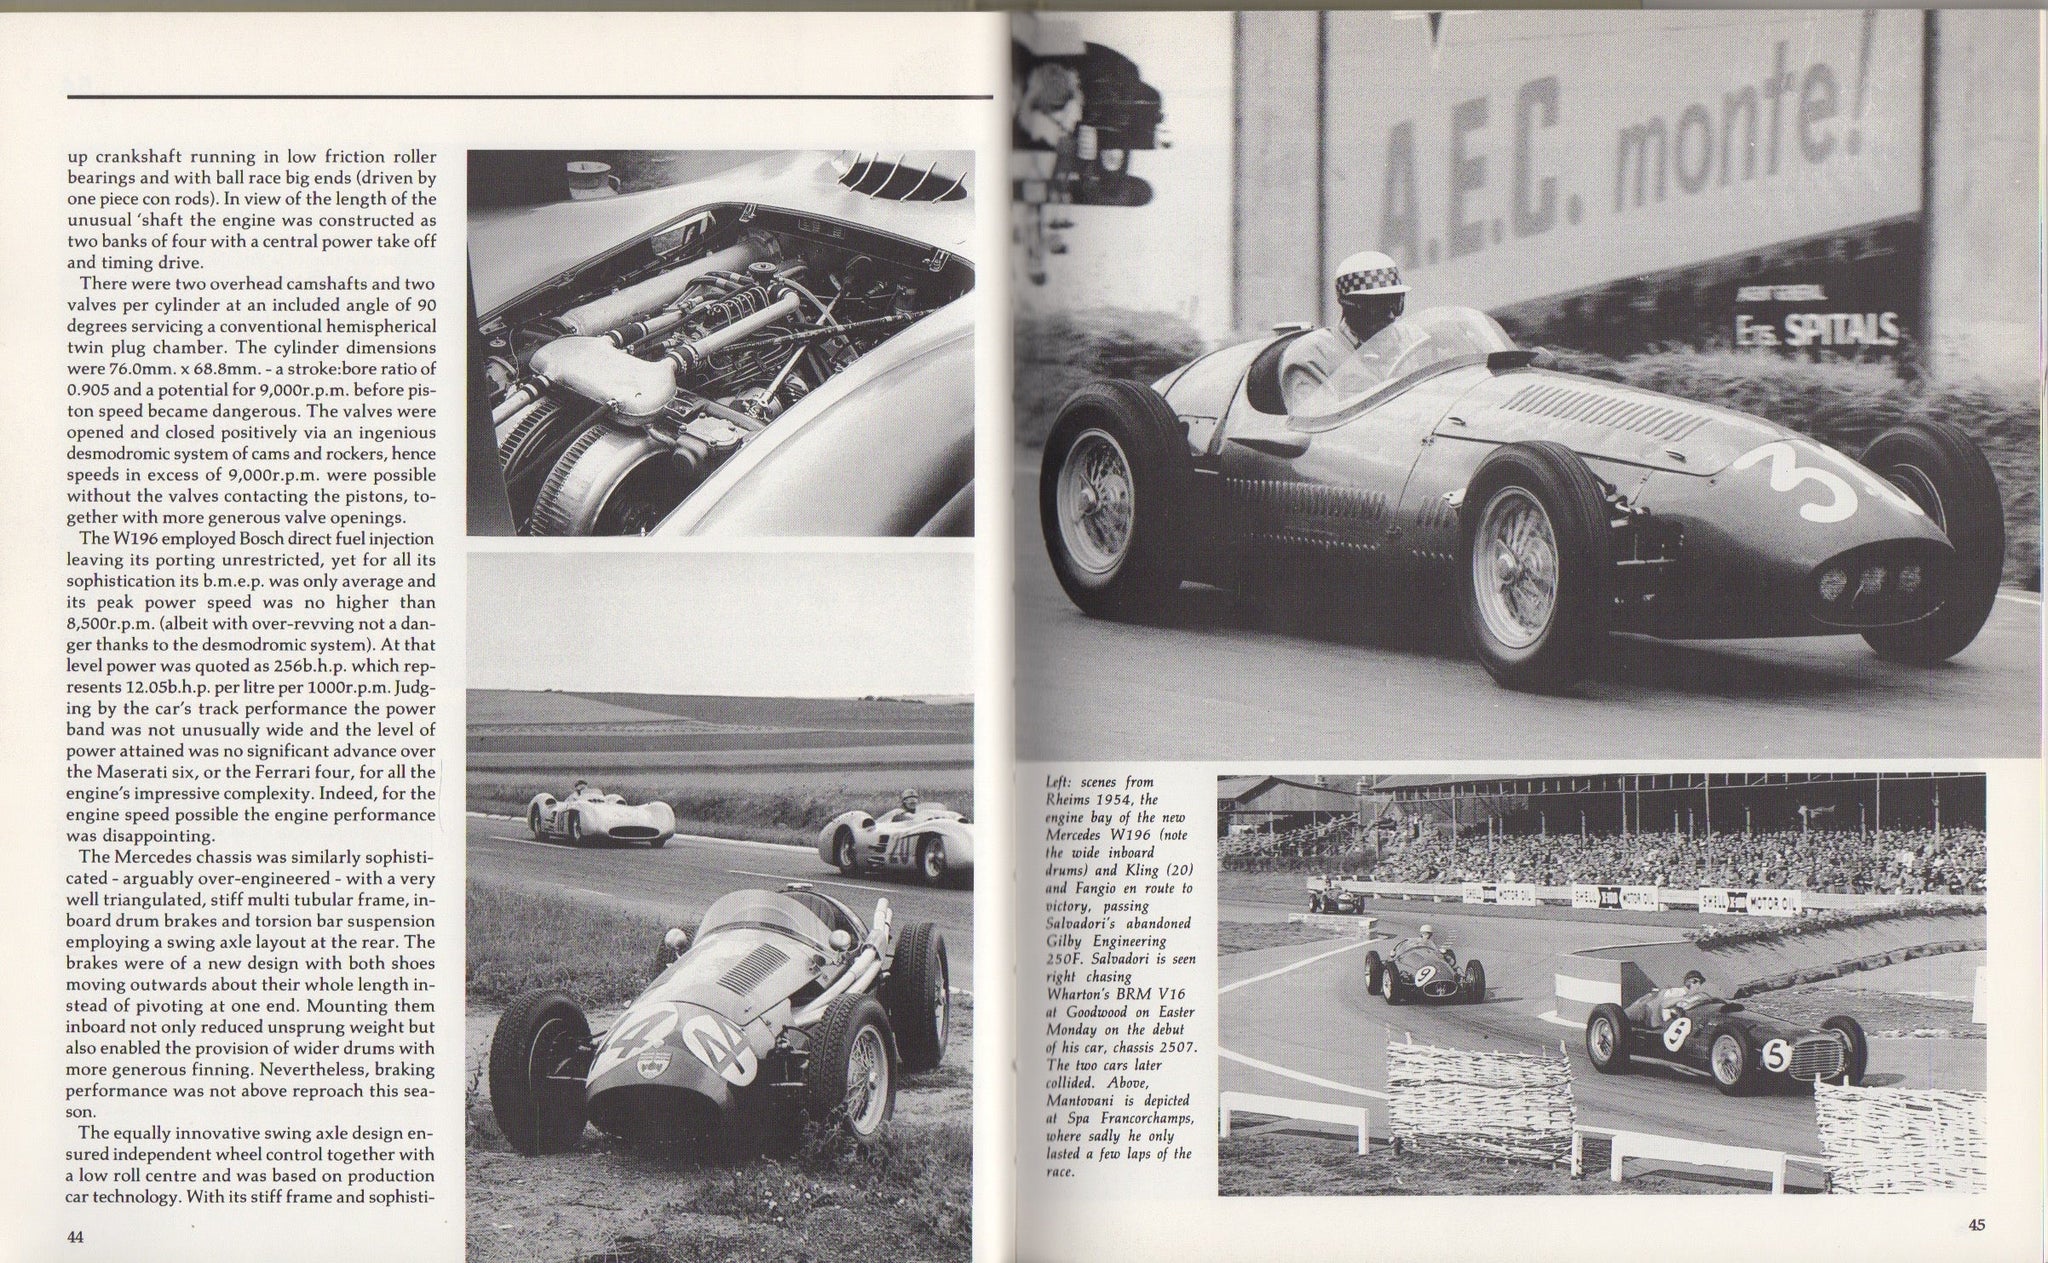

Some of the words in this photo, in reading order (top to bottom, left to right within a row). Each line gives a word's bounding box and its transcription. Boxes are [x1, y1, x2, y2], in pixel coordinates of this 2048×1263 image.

[67, 153, 88, 167] up
[95, 147, 183, 164] crankshaft
[190, 149, 256, 167] running
[264, 150, 279, 164] in
[287, 148, 317, 164] low
[325, 147, 385, 164] friction
[393, 148, 438, 164] roller
[79, 275, 128, 291] There
[131, 280, 171, 291] were
[175, 278, 207, 291] two
[209, 275, 283, 291] overhead
[286, 275, 368, 291] camshafts
[371, 275, 401, 291] and
[404, 278, 436, 291] two
[67, 405, 94, 418] ton
[98, 402, 144, 422] speed
[147, 402, 209, 418] became
[212, 402, 301, 422] dangerous.
[305, 402, 339, 418] The
[342, 402, 393, 418] valves
[396, 407, 437, 418] were
[78, 529, 110, 545] The
[113, 530, 159, 546] W196
[161, 530, 236, 550] employed
[239, 529, 285, 546] Bosch
[287, 530, 333, 546] direct
[335, 530, 366, 546] fuel
[369, 531, 435, 550] injection
[1045, 774, 1072, 791] Left:
[1080, 778, 1117, 788] scenes
[1124, 774, 1155, 791] from
[1046, 791, 1091, 806] Rheims
[1096, 793, 1135, 807] 1954,
[1139, 791, 1159, 806] the
[65, 807, 120, 825] engine
[124, 806, 170, 826] speed
[174, 805, 239, 826] possible
[244, 805, 270, 822] the
[274, 808, 329, 825] engine
[333, 806, 437, 826] performance
[1045, 810, 1084, 827] engine
[1090, 809, 1113, 827] bay
[1118, 809, 1132, 827] of
[1137, 809, 1156, 824] the
[1162, 814, 1186, 824] new
[1045, 827, 1101, 842] Mercedes
[1110, 827, 1151, 841] W196
[1159, 827, 1188, 842] (note
[1045, 844, 1064, 859] the
[1071, 844, 1100, 859] wide
[1108, 844, 1156, 859] inboard
[1045, 862, 1089, 878] drums)
[1094, 862, 1118, 877] and
[1124, 862, 1160, 880] Kling
[1166, 862, 1194, 877] (20)
[1045, 880, 1068, 895] and
[1075, 880, 1117, 898] Fangio
[1123, 884, 1137, 895] en
[1144, 882, 1175, 895] route
[1181, 882, 1194, 894] to
[1045, 899, 1092, 916] victory,
[1103, 899, 1150, 916] passing
[1126, 915, 1192, 930] abandoned
[1046, 933, 1082, 951] Gilby
[1092, 933, 1167, 951] Engineering
[66, 954, 118, 970] brakes
[124, 959, 165, 970] were
[169, 954, 188, 970] of
[192, 960, 202, 970] a
[208, 959, 242, 970] new
[247, 954, 299, 974] design
[304, 954, 343, 971] with
[348, 954, 386, 971] both
[391, 954, 436, 971] shoes
[1046, 951, 1084, 966] 250F.
[1090, 950, 1150, 966] Salvadori
[1156, 952, 1167, 965] is
[1172, 955, 1197, 965] seen
[1046, 968, 1076, 986] right
[1086, 968, 1133, 986] chasing
[1417, 967, 1432, 983] 9
[1116, 986, 1153, 1001] BRM
[1158, 987, 1186, 1001] V16
[1045, 1006, 1057, 1019] at
[1065, 1004, 1128, 1019] Goodwood
[1135, 1008, 1150, 1019] on
[1158, 1004, 1196, 1018] Easter
[1046, 1021, 1098, 1039] Monday
[1104, 1026, 1120, 1036] on
[1127, 1021, 1146, 1036] the
[1151, 1021, 1185, 1036] debut
[1045, 1040, 1058, 1057] of
[1061, 1039, 1080, 1054] his
[1084, 1044, 1108, 1055] car,
[1112, 1039, 1155, 1054] chassis
[1159, 1041, 1198, 1054] 2507.
[1768, 1042, 1785, 1069] 5
[1046, 1057, 1070, 1072] The
[1075, 1059, 1098, 1072] two
[1103, 1061, 1129, 1072] cars
[1134, 1057, 1163, 1072] later
[1045, 1074, 1095, 1089] collided.
[1106, 1074, 1150, 1091] Above,
[1046, 1093, 1115, 1107] Mantovani
[1124, 1093, 1135, 1107] is
[1143, 1092, 1191, 1110] depicted
[1045, 1112, 1058, 1125] at
[1067, 1110, 1090, 1128] Spa
[1100, 1110, 1195, 1127] Francorchamps,
[1046, 1128, 1082, 1142] where
[1088, 1127, 1121, 1145] sadly
[1127, 1128, 1142, 1142] he
[1148, 1128, 1175, 1145] only
[65, 1145, 110, 1161] sured
[112, 1145, 212, 1165] independent
[215, 1145, 263, 1162] wheel
[265, 1146, 323, 1162] control
[326, 1145, 396, 1165] together
[398, 1145, 435, 1162] with
[1046, 1145, 1081, 1160] lasted
[1085, 1150, 1094, 1160] a
[1098, 1146, 1121, 1163] few
[1127, 1145, 1152, 1163] laps
[1156, 1146, 1170, 1163] of
[1173, 1145, 1193, 1160] the
[1046, 1168, 1075, 1178] race.
[1968, 1218, 1986, 1232] 45
[66, 1230, 85, 1244] 44
